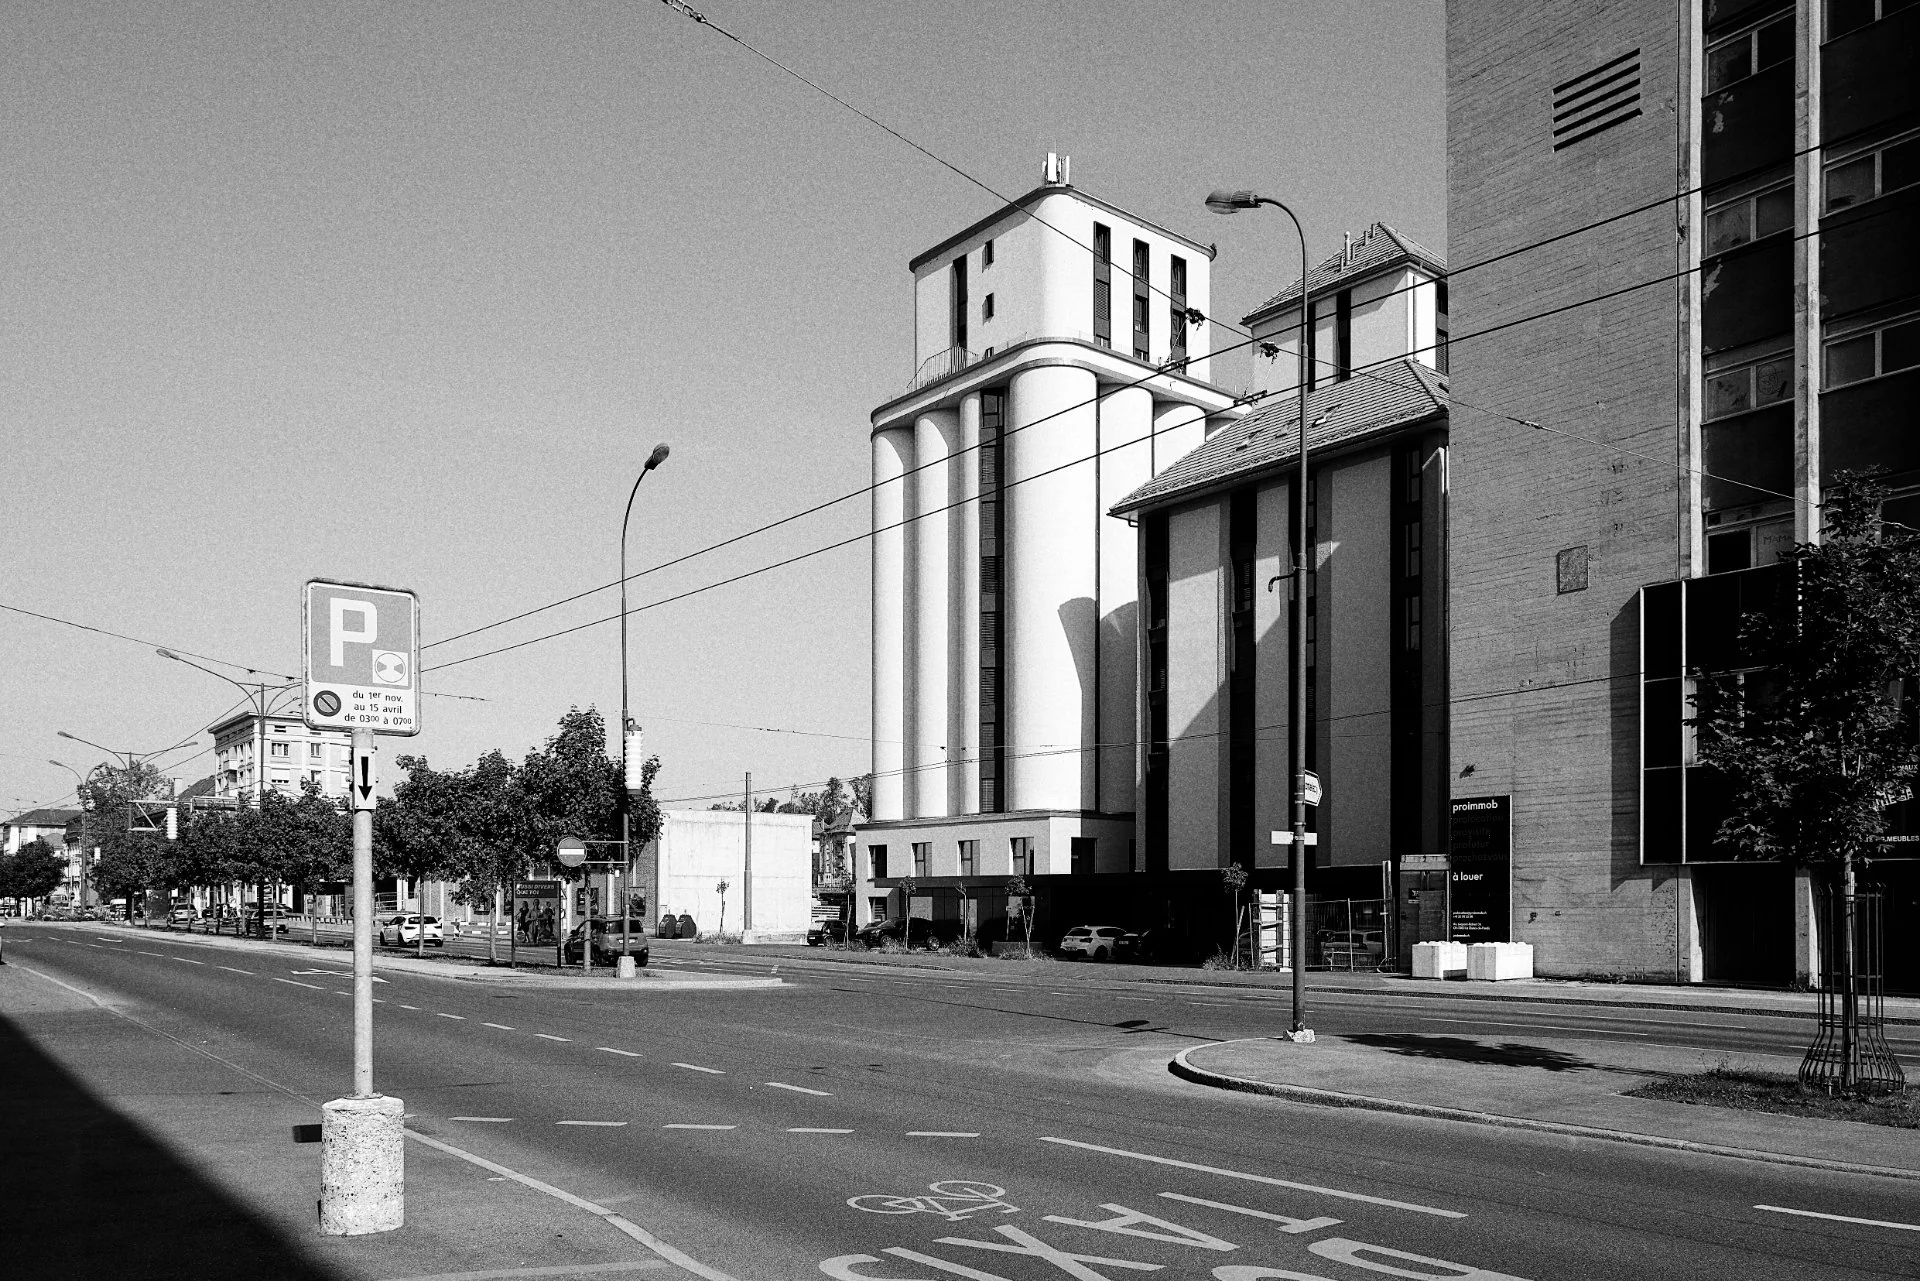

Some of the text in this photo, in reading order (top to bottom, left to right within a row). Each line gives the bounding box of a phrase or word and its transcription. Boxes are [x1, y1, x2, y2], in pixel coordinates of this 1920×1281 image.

[330, 597, 378, 667] P
[352, 690, 403, 702] du 1er nov.
[354, 704, 402, 714] au 15 avril
[344, 713, 412, 725] de 0300 à 0700
[1452, 799, 1499, 814] proimmob
[1452, 870, 1484, 881] à louer
